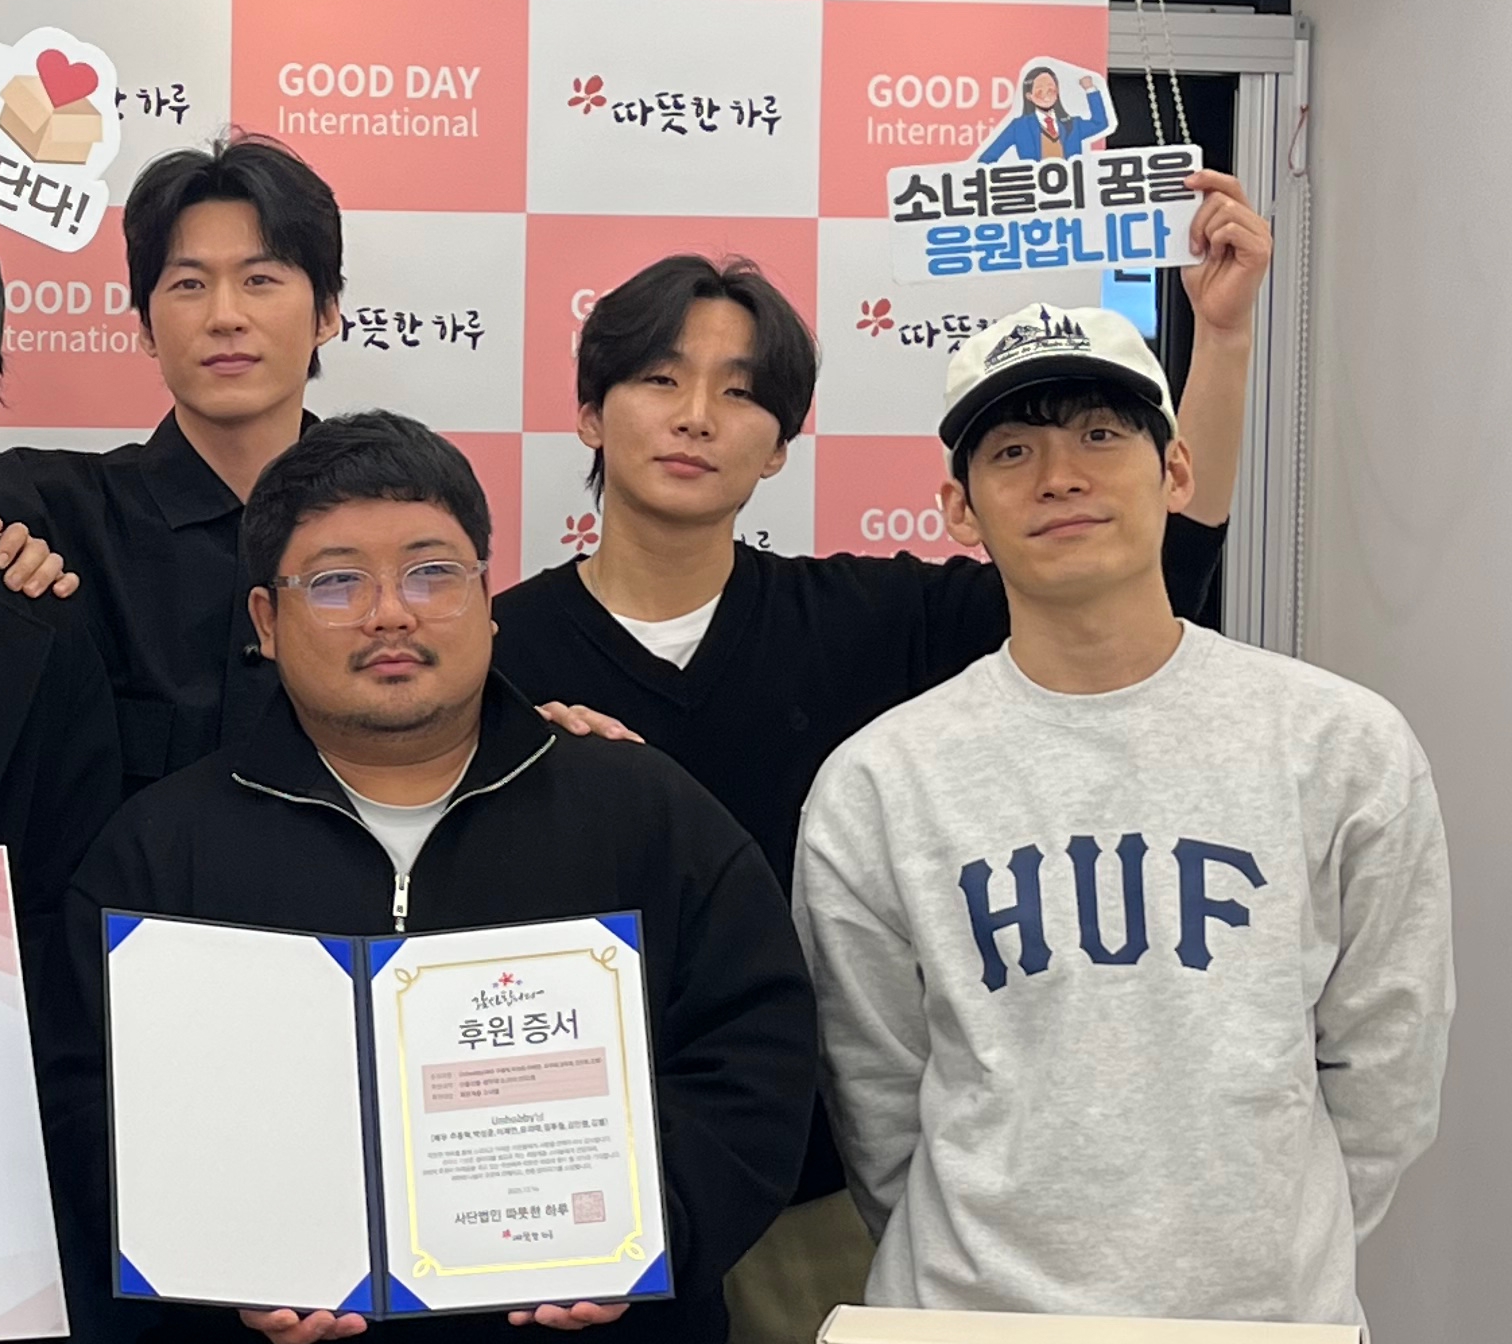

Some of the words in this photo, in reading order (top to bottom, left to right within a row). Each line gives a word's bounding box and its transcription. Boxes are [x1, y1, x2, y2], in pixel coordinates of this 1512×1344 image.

[278, 63, 393, 98] GOOD
[406, 65, 480, 99] DAY
[868, 74, 979, 109] GOOD
[136, 83, 190, 123] 하루
[278, 106, 478, 138] International
[611, 91, 720, 136] 따뜻한
[730, 96, 782, 136] 하루
[894, 161, 1084, 223] 소녀들의
[1098, 152, 1202, 203] 꿈을
[926, 208, 1170, 275] 응원합니다
[4, 280, 92, 315] OOD
[433, 311, 485, 351] 하루
[861, 508, 945, 541] GOO
[958, 832, 1268, 993] HUF
[458, 1015, 515, 1050] 후원
[522, 1009, 579, 1045] 증서
